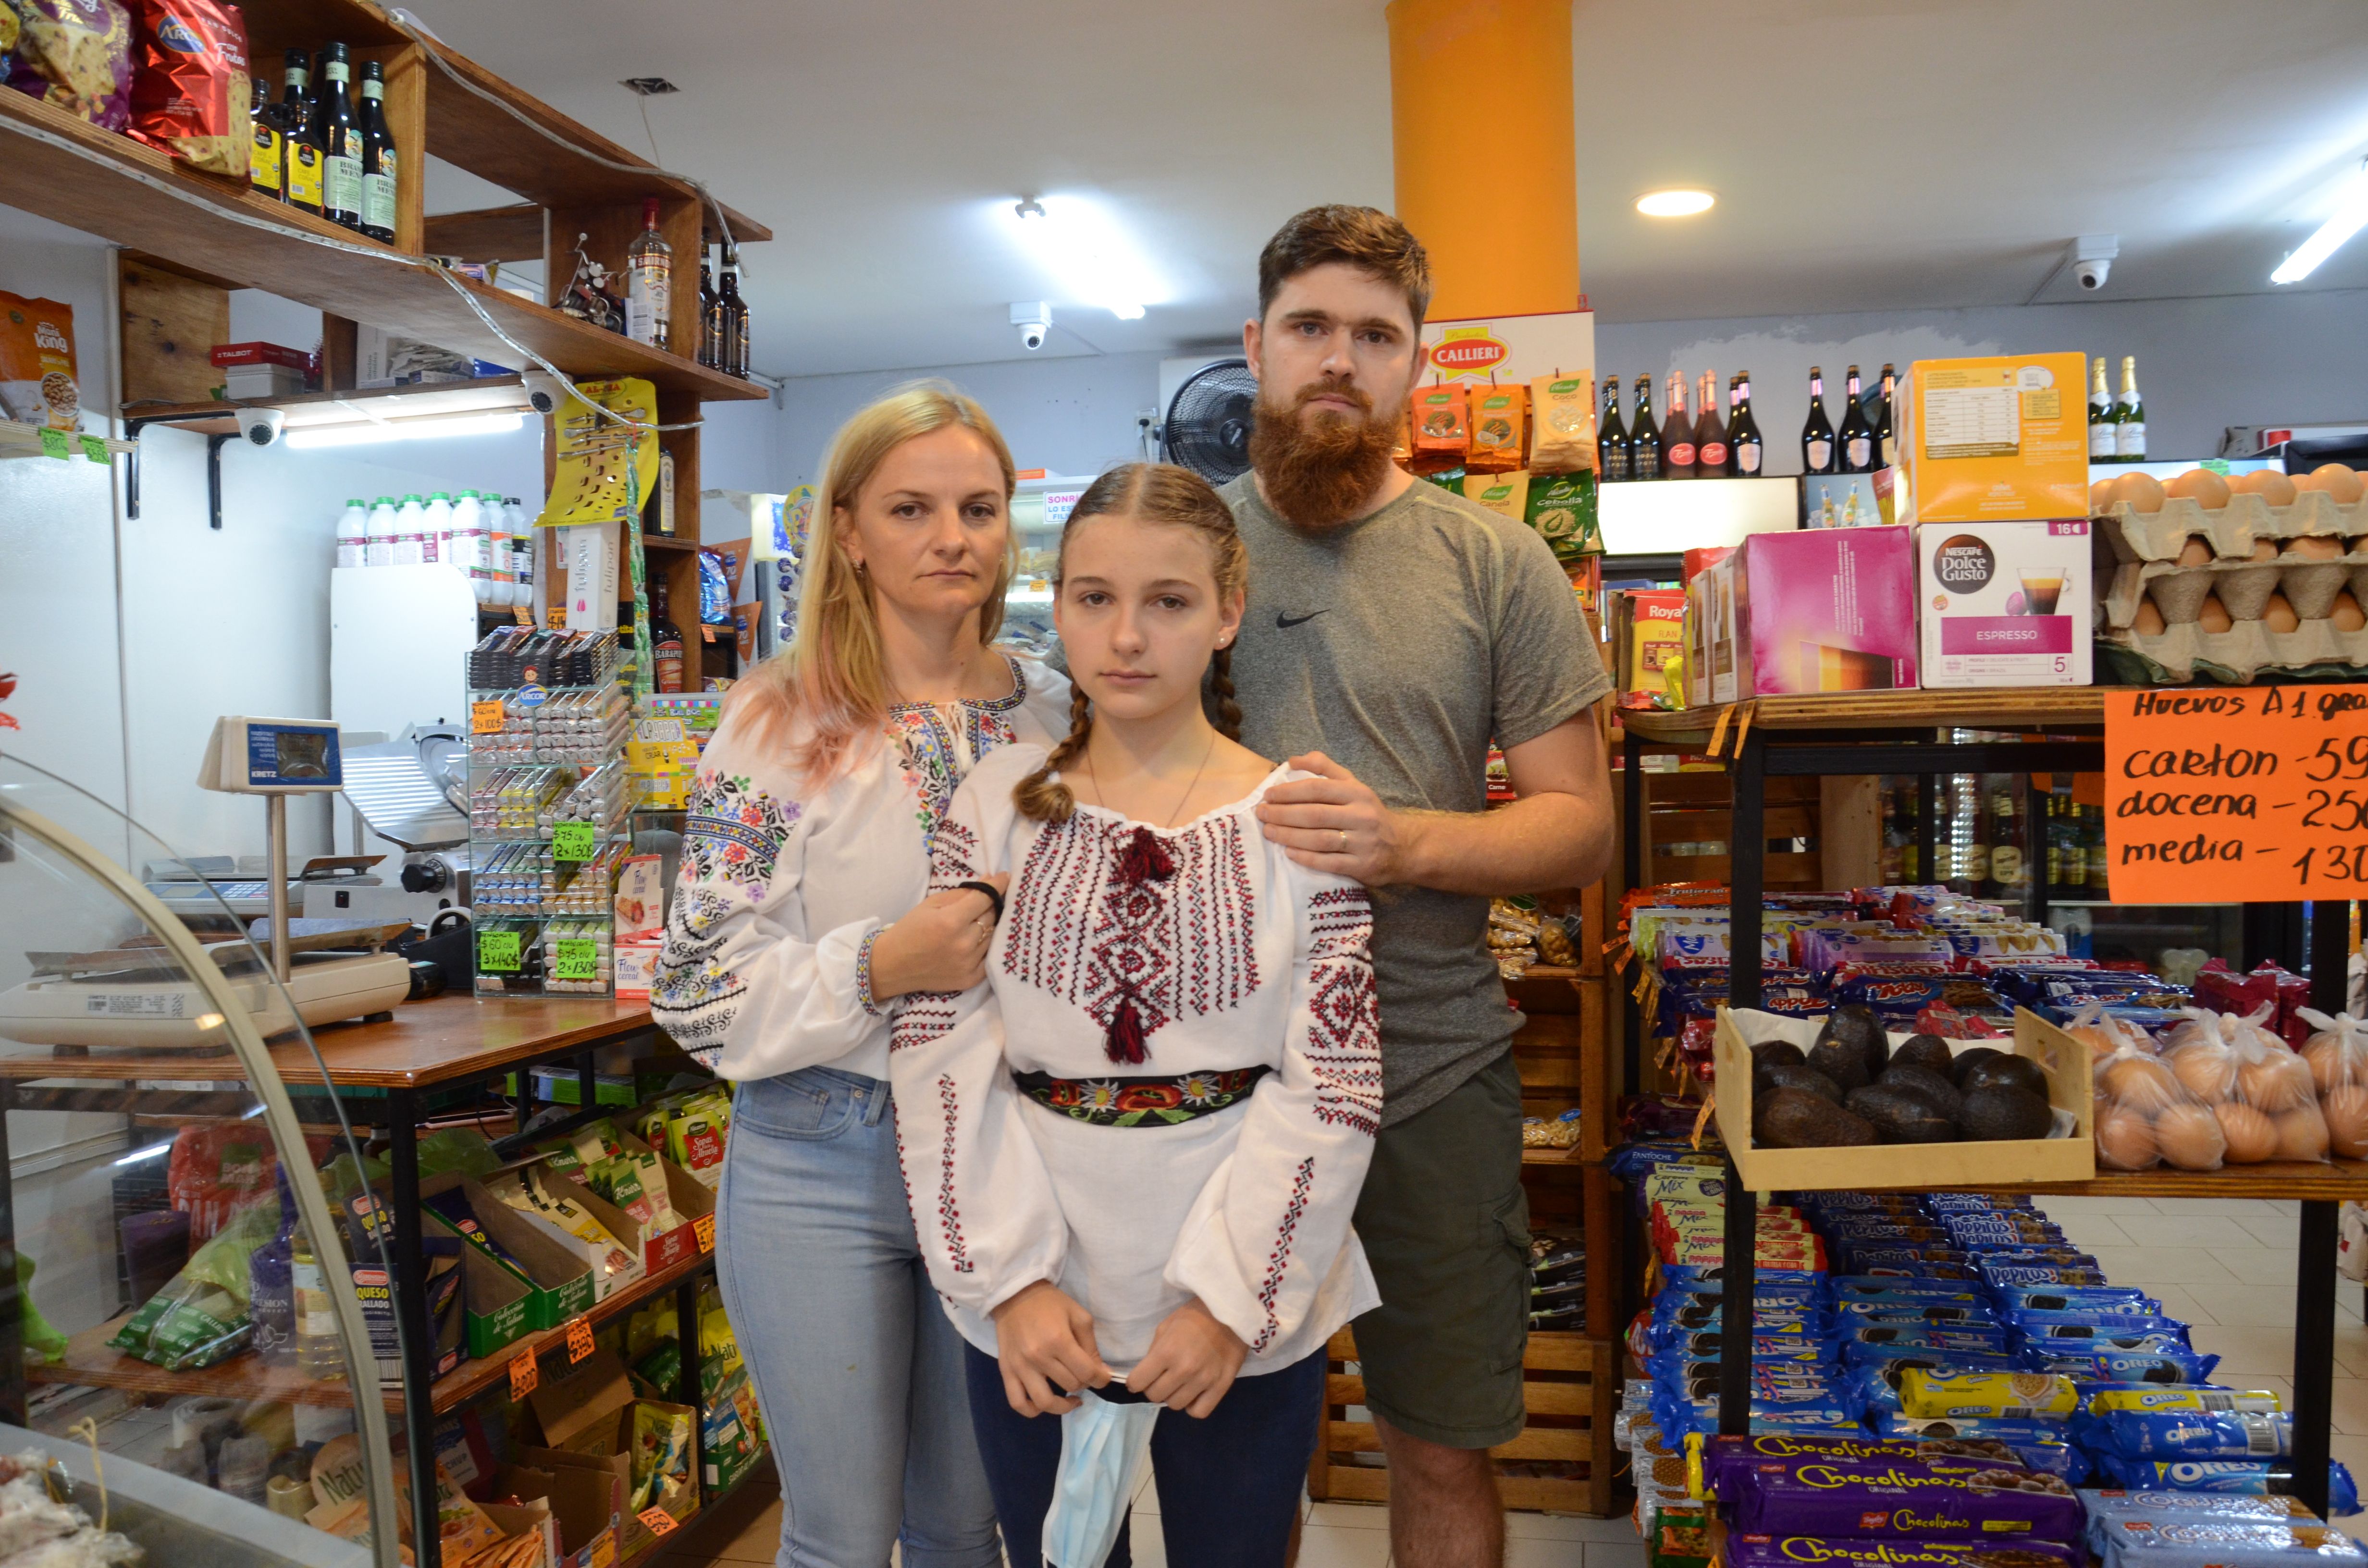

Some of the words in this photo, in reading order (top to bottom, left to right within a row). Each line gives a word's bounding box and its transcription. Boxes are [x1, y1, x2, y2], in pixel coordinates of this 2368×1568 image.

[34, 332, 68, 353] King
[1437, 346, 1500, 363] CALLIERI
[1048, 493, 1080, 504] SONRÍ
[1480, 499, 1510, 507] Canela
[1537, 497, 1583, 505] Cebolla
[2056, 524, 2071, 535] 16
[575, 538, 588, 593] tulipan
[603, 541, 615, 594] tulipan
[1942, 557, 1986, 572] Dolce
[1942, 571, 1987, 581] Gusto
[1649, 605, 1682, 619] Roya
[1976, 630, 2037, 640] ESPRESSO
[2054, 656, 2065, 673] 5
[519, 690, 546, 700] ARCOR
[668, 708, 685, 716] BULL
[2134, 692, 2245, 717] Huevos
[2117, 790, 2258, 820] docena
[2121, 833, 2244, 865] media
[617, 958, 639, 971] Flow
[617, 970, 639, 980] cereal
[1865, 981, 1931, 1001] Toddy
[693, 1136, 713, 1151] Sopas
[1632, 1151, 1672, 1161] FANTOCHE
[616, 1182, 642, 1200] Knorr
[1656, 1180, 1685, 1196] Mix
[356, 1286, 389, 1300] QUESO
[2111, 1359, 2163, 1372] OREO
[2140, 1393, 2187, 1406] OREO
[1946, 1406, 1993, 1417] OREO
[2165, 1427, 2214, 1443] OREO
[1753, 1435, 1917, 1458] Chocolinas
[1796, 1465, 1968, 1489] Chocolinas
[2168, 1460, 2264, 1485] OREO
[1893, 1509, 1970, 1531] Chocolinas
[1780, 1537, 1959, 1566] Chocolinas
